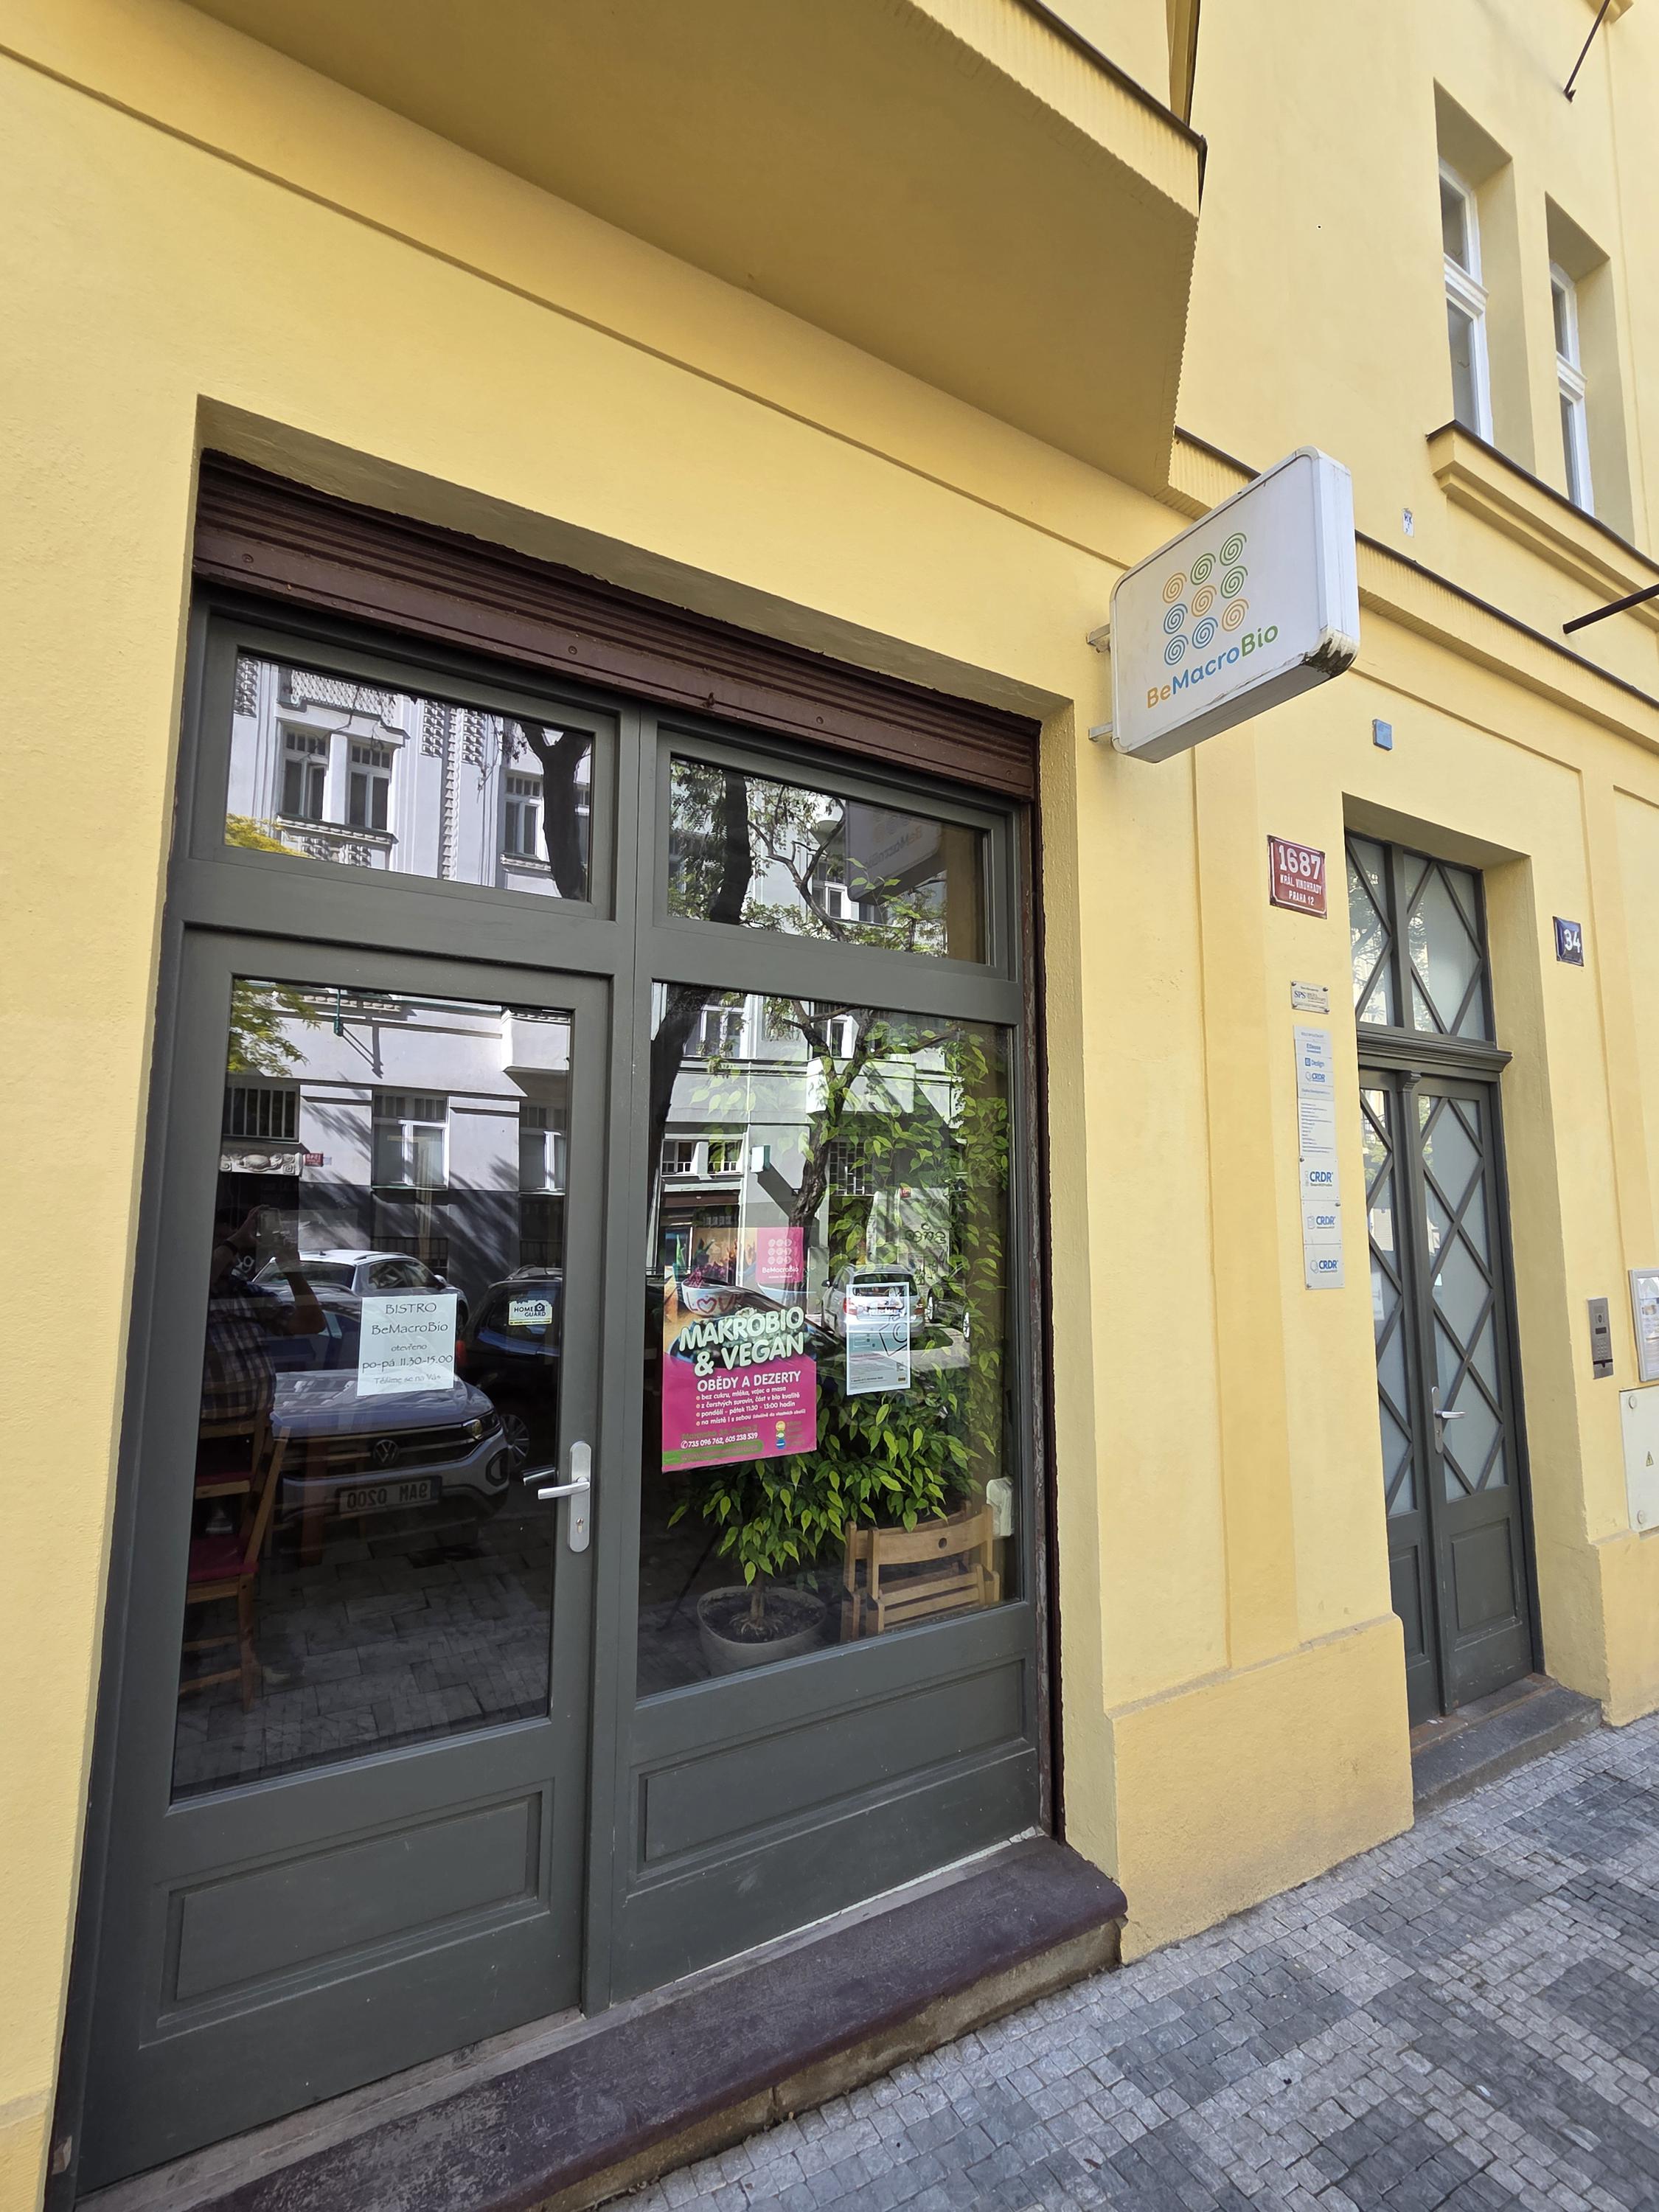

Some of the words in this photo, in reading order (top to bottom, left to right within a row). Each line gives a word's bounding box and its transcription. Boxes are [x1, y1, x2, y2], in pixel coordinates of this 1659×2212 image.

[1147, 625, 1279, 709] BeMacroBio
[1279, 845, 1321, 880] 1687
[1288, 890, 1306, 903] PRAHA
[1307, 896, 1315, 905] 12
[1564, 929, 1581, 953] 34
[1310, 1171, 1332, 1183] CRDR
[1316, 1216, 1335, 1225] CRDR
[1318, 1260, 1338, 1270] CRDR
[386, 1302, 437, 1314] BISTRO
[372, 1321, 448, 1335] BeMacroBio
[679, 1306, 804, 1352] MAKROBIO
[391, 1343, 427, 1352] otevřeno
[694, 1351, 714, 1377] &
[721, 1332, 804, 1370] VEGAN
[362, 1359, 394, 1374] po-pá
[697, 1375, 738, 1392] OBĚDY
[742, 1375, 750, 1388] A
[754, 1371, 801, 1386] DEZERTY
[706, 1400, 732, 1408] čerstvých
[701, 1408, 723, 1418] pondělí
[729, 1406, 745, 1416] pátek
[712, 1437, 724, 1445] 762,
[736, 1433, 747, 1441] 238
